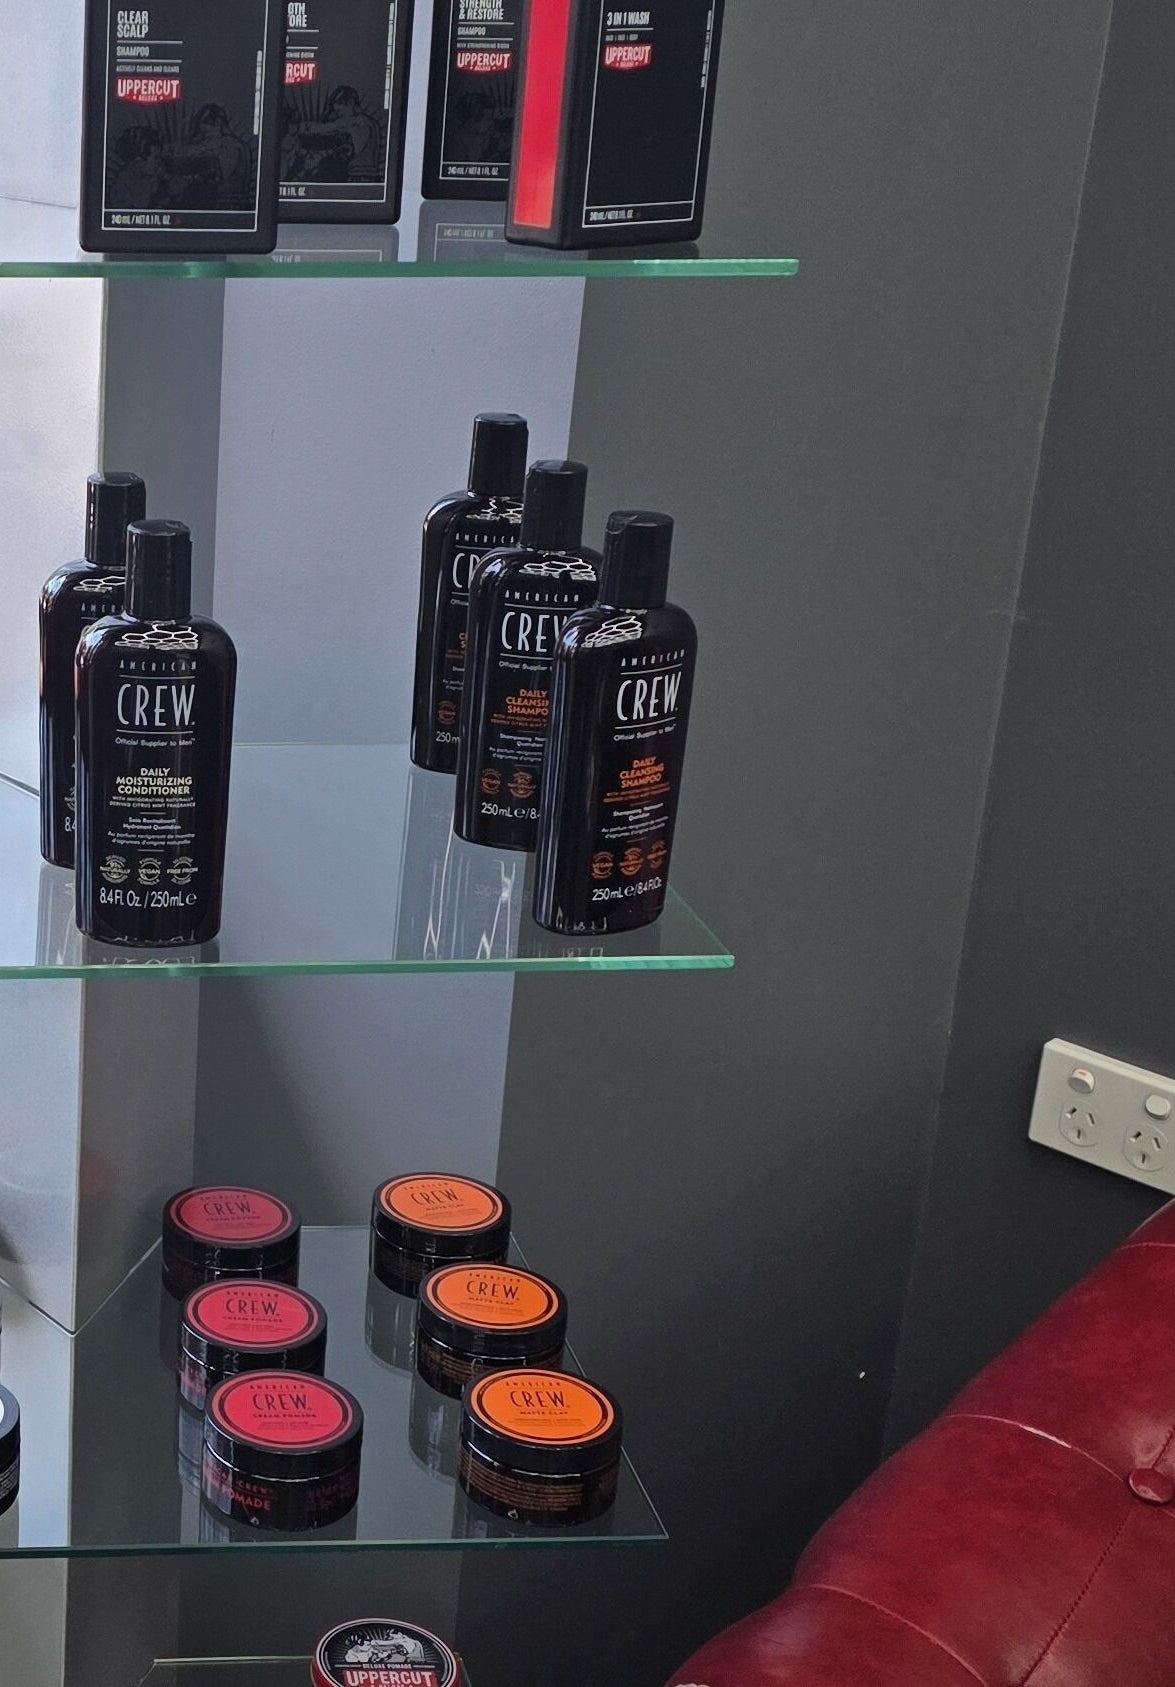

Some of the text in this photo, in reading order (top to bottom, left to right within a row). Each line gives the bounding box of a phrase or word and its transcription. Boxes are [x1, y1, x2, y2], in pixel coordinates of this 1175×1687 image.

[117, 10, 149, 24] CLEAR
[458, 8, 504, 20] & RESTORE
[606, 11, 650, 26] 3 IN 1 WASH
[116, 24, 149, 38] SCALP
[116, 46, 150, 57] SHAMPOO
[605, 46, 651, 65] UPPERCUT
[457, 52, 511, 69] UPPERCUT
[286, 62, 316, 80] RCUT
[117, 79, 180, 99] UPPERCUT
[455, 533, 514, 543] AMERICA
[505, 590, 579, 603] AMERICAN
[620, 649, 685, 667] AMERICAN
[119, 659, 197, 672] AMERICAN
[519, 689, 548, 698] DAILY
[507, 706, 549, 716] SHAMPO
[632, 756, 657, 768] DAILY
[140, 767, 171, 777] DAILY
[619, 763, 665, 780] CLEANSING
[115, 776, 193, 786] MOISTURIZING
[620, 773, 662, 789] SHAMPOO
[117, 785, 190, 795] CONDITIONER
[346, 1670, 433, 1687] UPPERCUT
